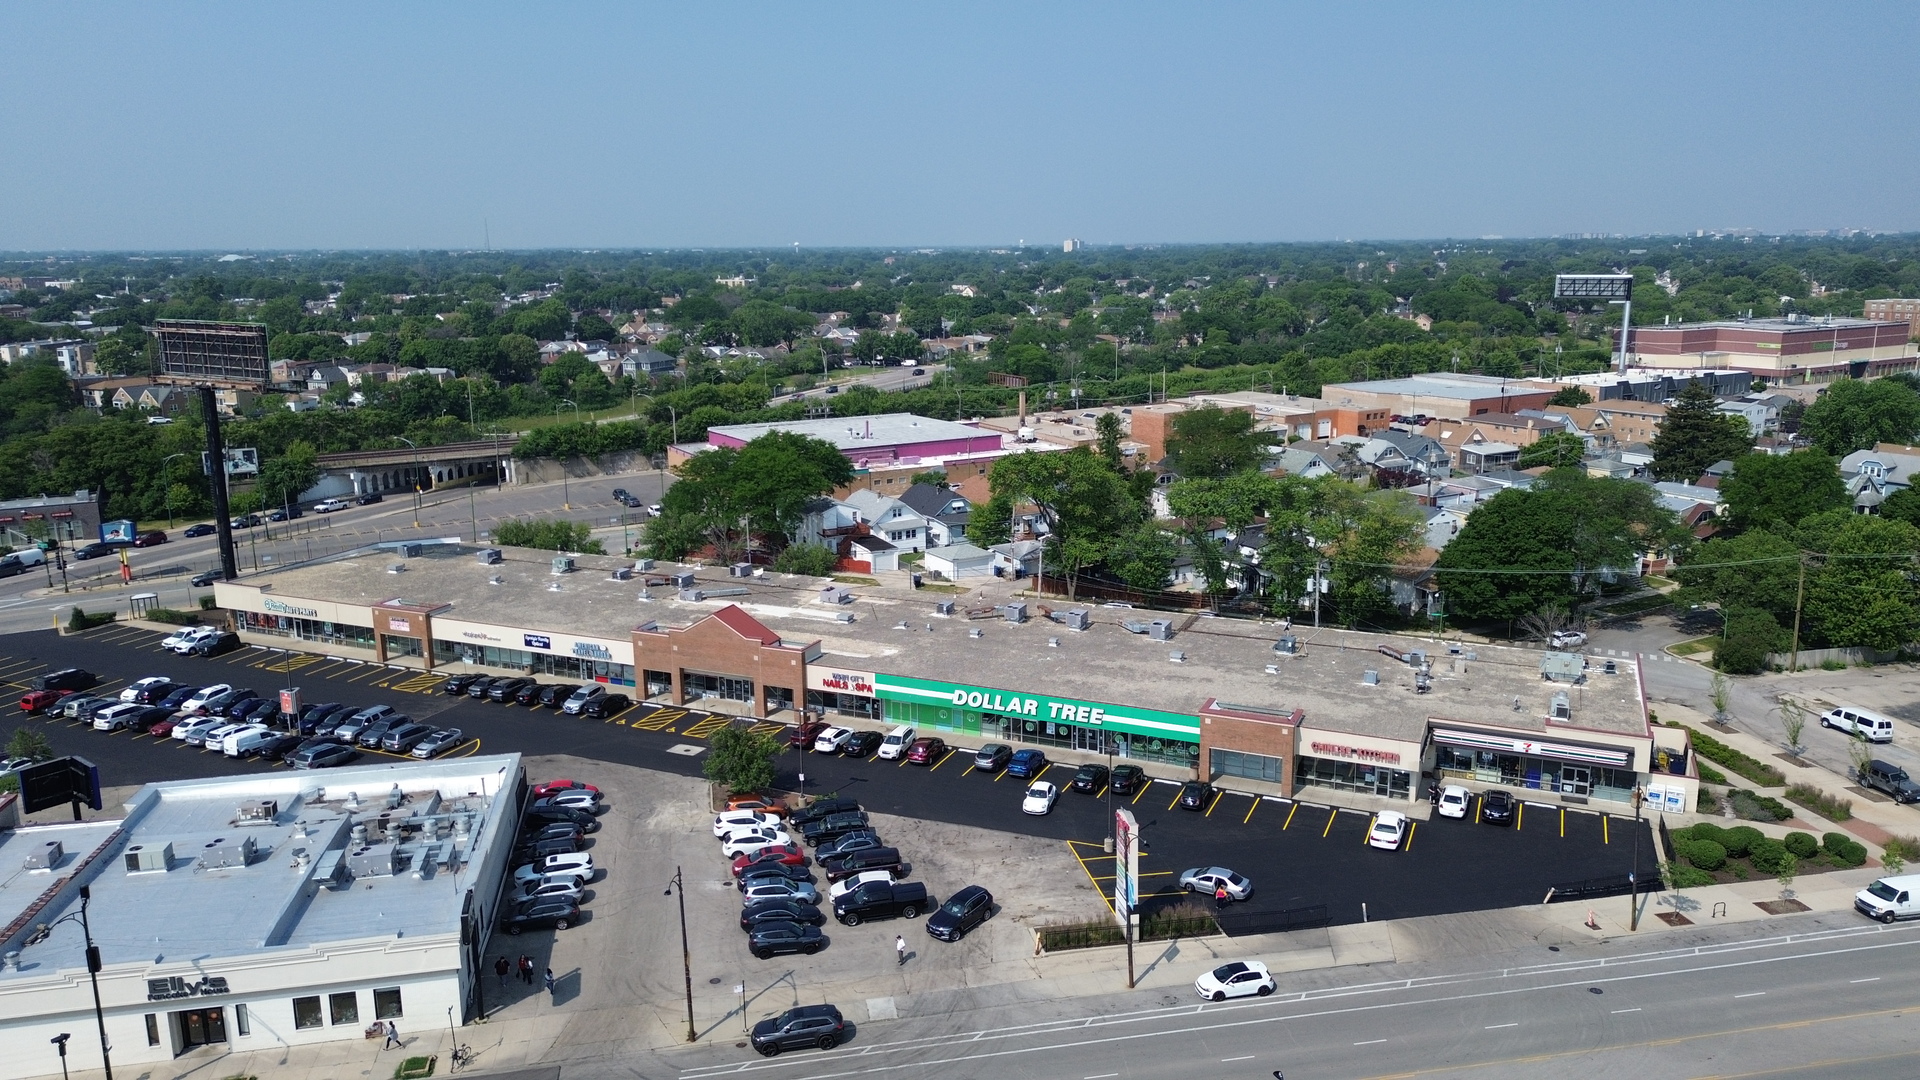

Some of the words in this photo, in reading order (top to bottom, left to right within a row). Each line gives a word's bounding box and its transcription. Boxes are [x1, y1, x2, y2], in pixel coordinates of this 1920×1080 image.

[822, 678, 849, 690] NAILS
[855, 682, 873, 694] SPA
[952, 689, 1039, 716] DOLLAR
[1048, 702, 1104, 725] TREE
[1311, 741, 1353, 757] CHINESE
[1356, 748, 1401, 763] KITCHEN
[147, 976, 228, 996] Elly's
[147, 991, 189, 1002] Pancake
[200, 987, 230, 996] House
